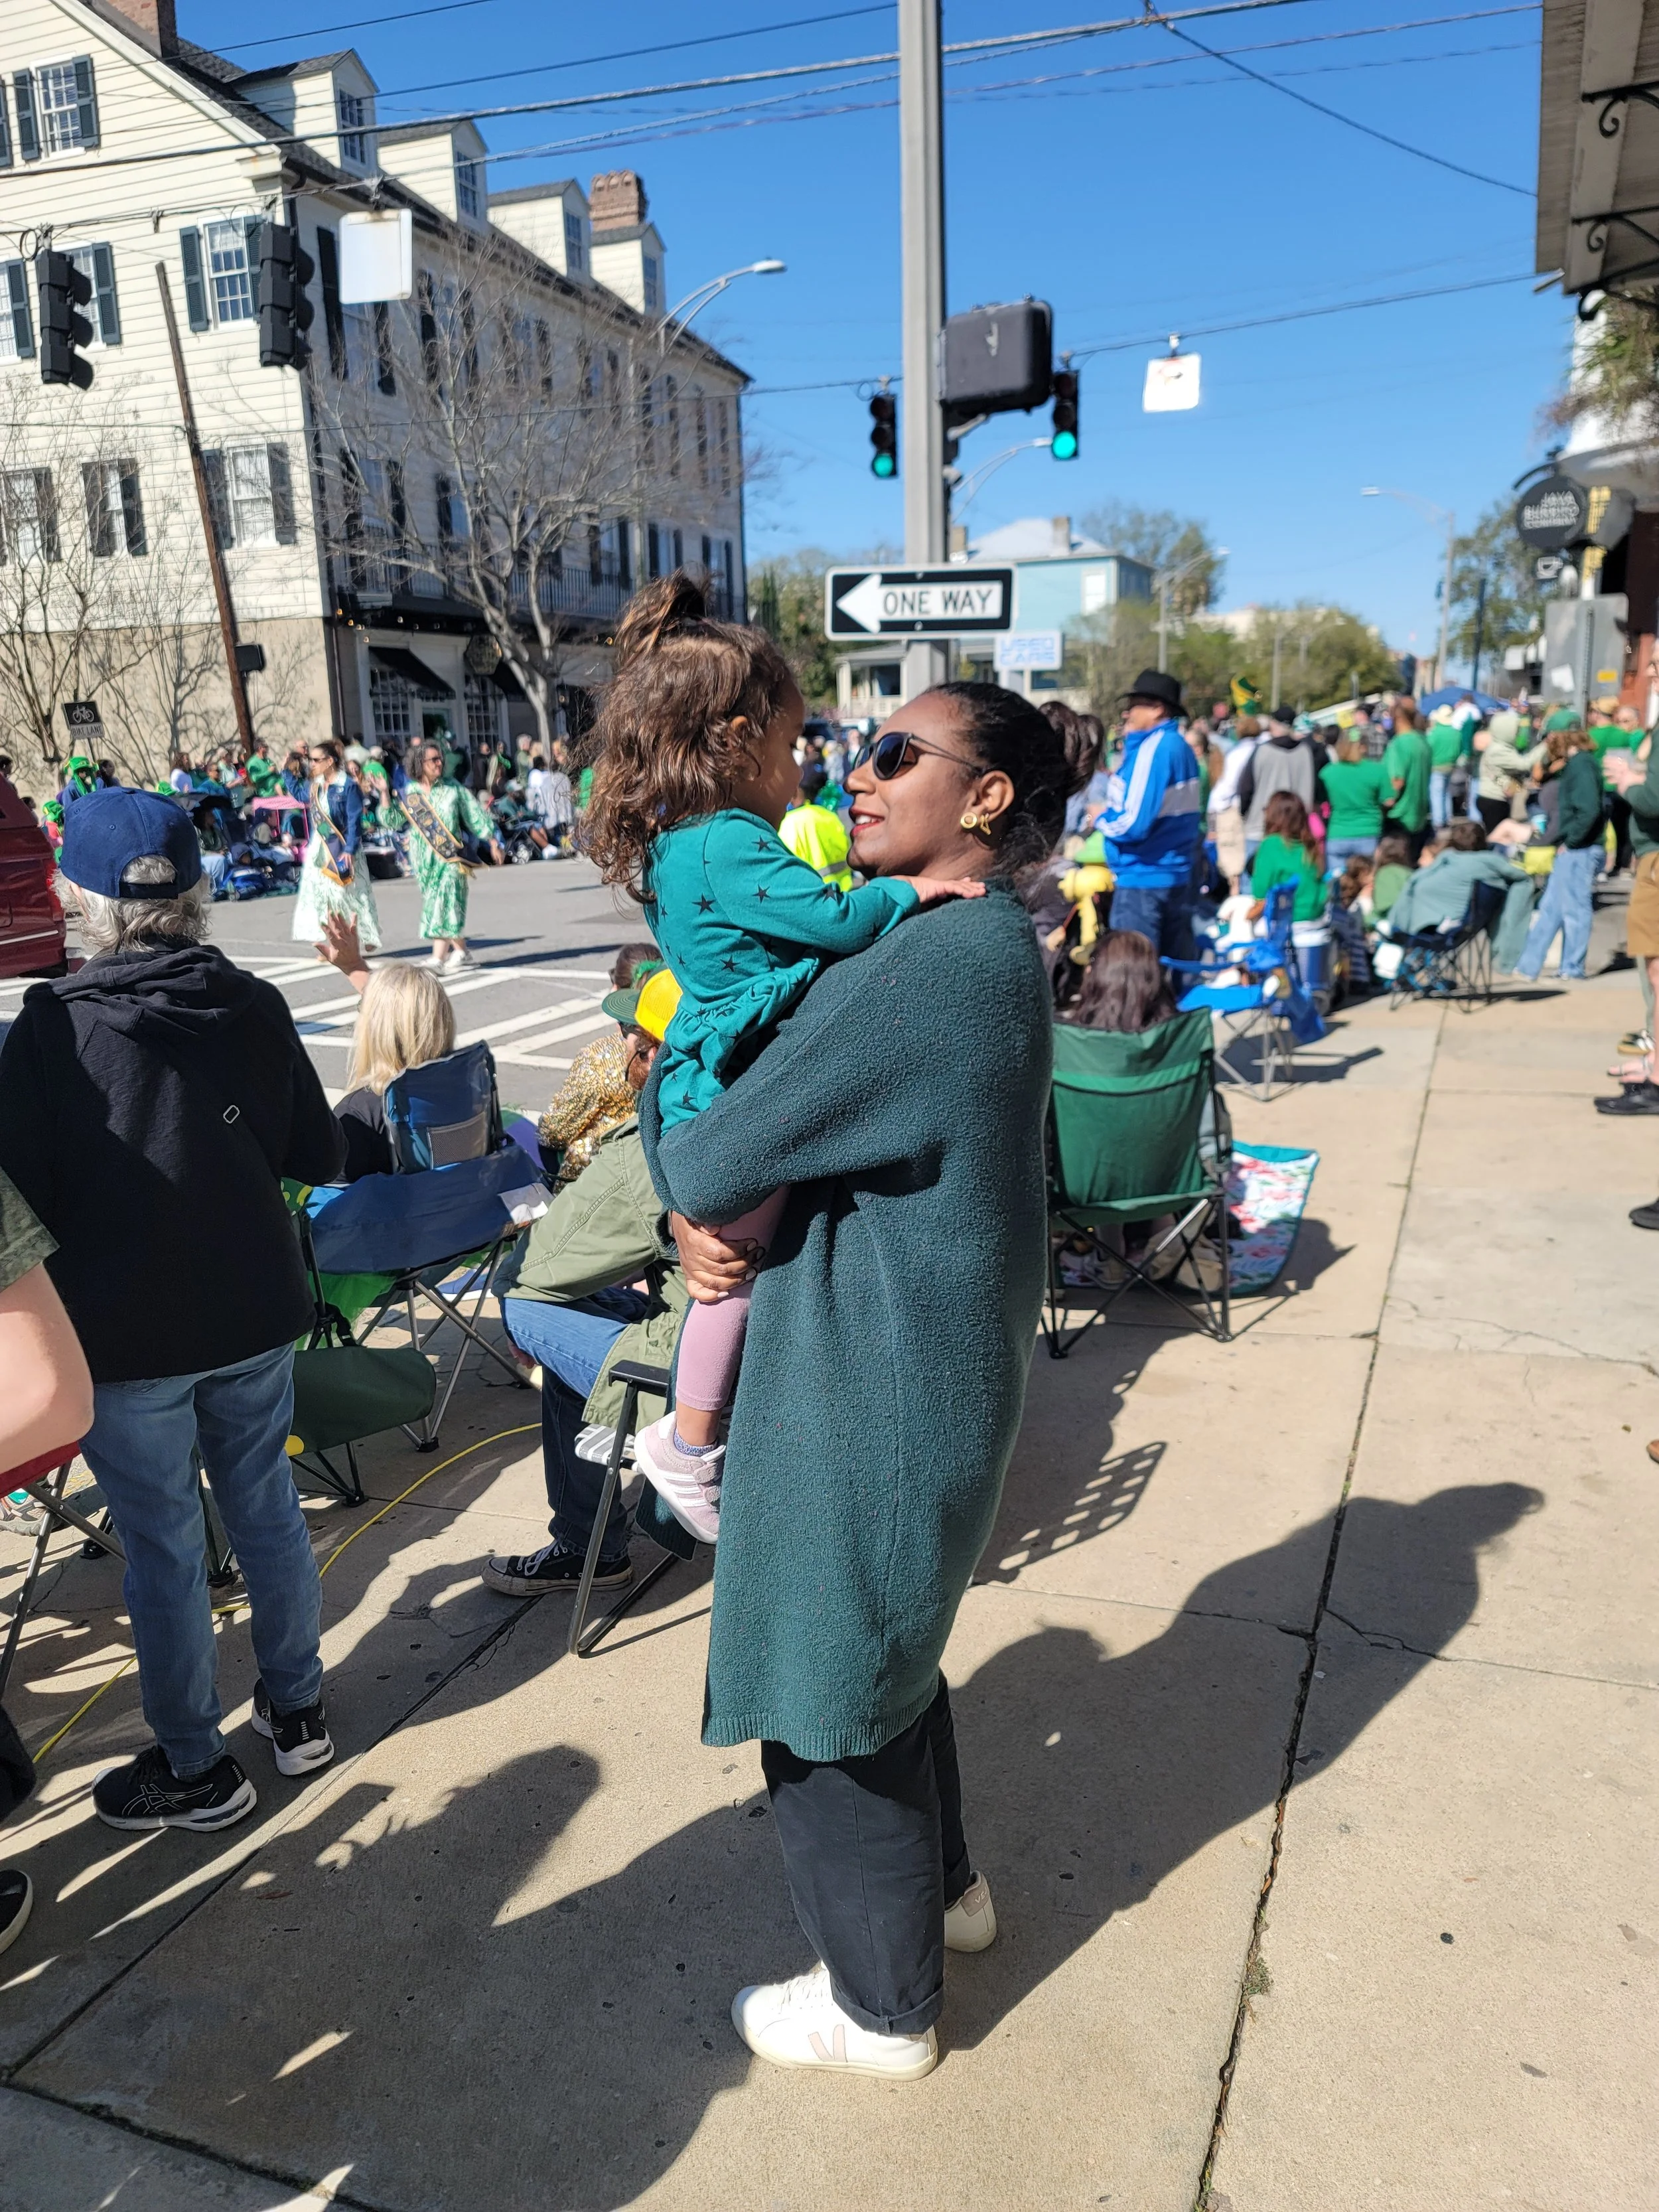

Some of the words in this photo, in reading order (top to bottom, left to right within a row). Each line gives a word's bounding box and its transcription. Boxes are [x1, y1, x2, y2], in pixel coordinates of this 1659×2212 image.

[883, 590, 932, 616] ONE
[942, 589, 992, 613] WAY
[72, 727, 86, 737] BIKE
[86, 725, 104, 735] LANE
